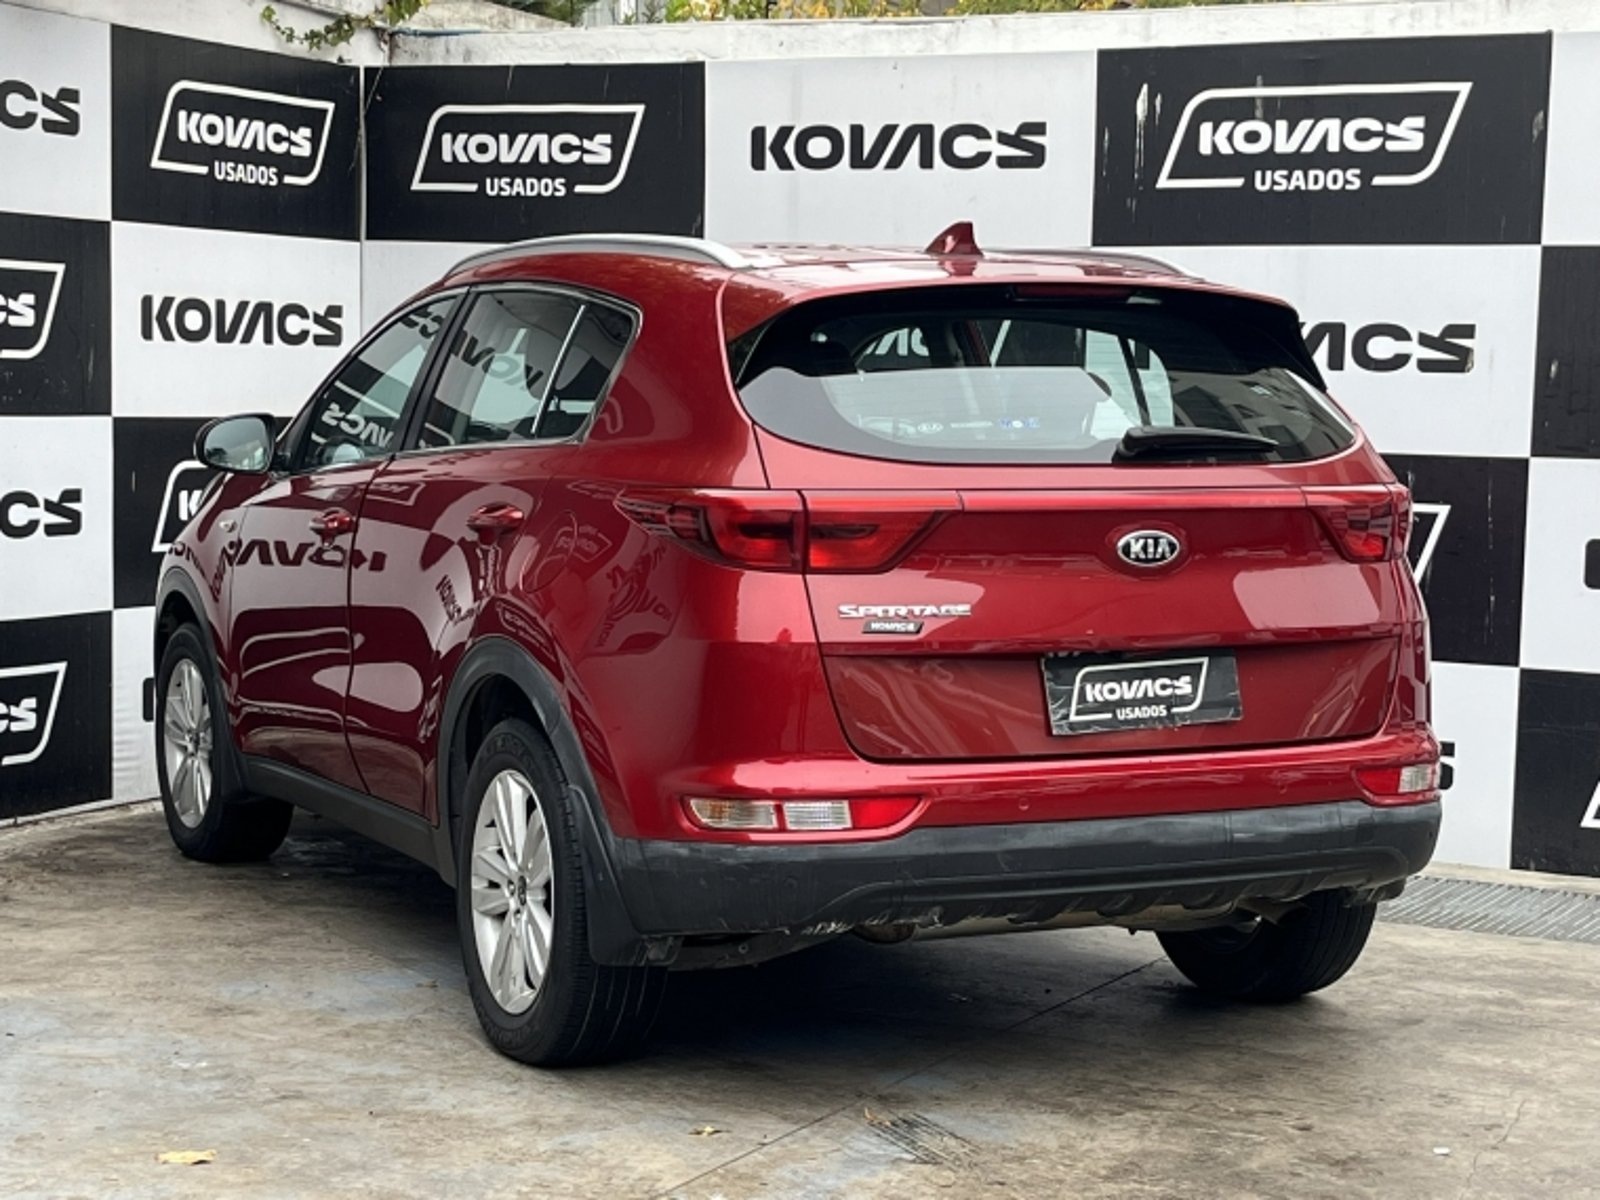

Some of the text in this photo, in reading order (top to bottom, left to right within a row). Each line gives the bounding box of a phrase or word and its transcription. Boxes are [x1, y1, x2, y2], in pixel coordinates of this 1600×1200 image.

[177, 110, 313, 157] KOVACS
[750, 121, 1047, 171] KOVACS
[1198, 116, 1426, 156] KOVACS
[440, 132, 613, 165] KOVACS
[213, 160, 279, 187] USADOS
[485, 177, 567, 197] USADOS
[1253, 168, 1362, 192] USADOS
[140, 294, 344, 347] KOVACS
[1300, 321, 1476, 373] ACS
[1129, 538, 1171, 559] KIA
[838, 604, 972, 618] SPORTAGE
[1084, 675, 1193, 703] KOVACS
[1115, 704, 1168, 721] USADOS
